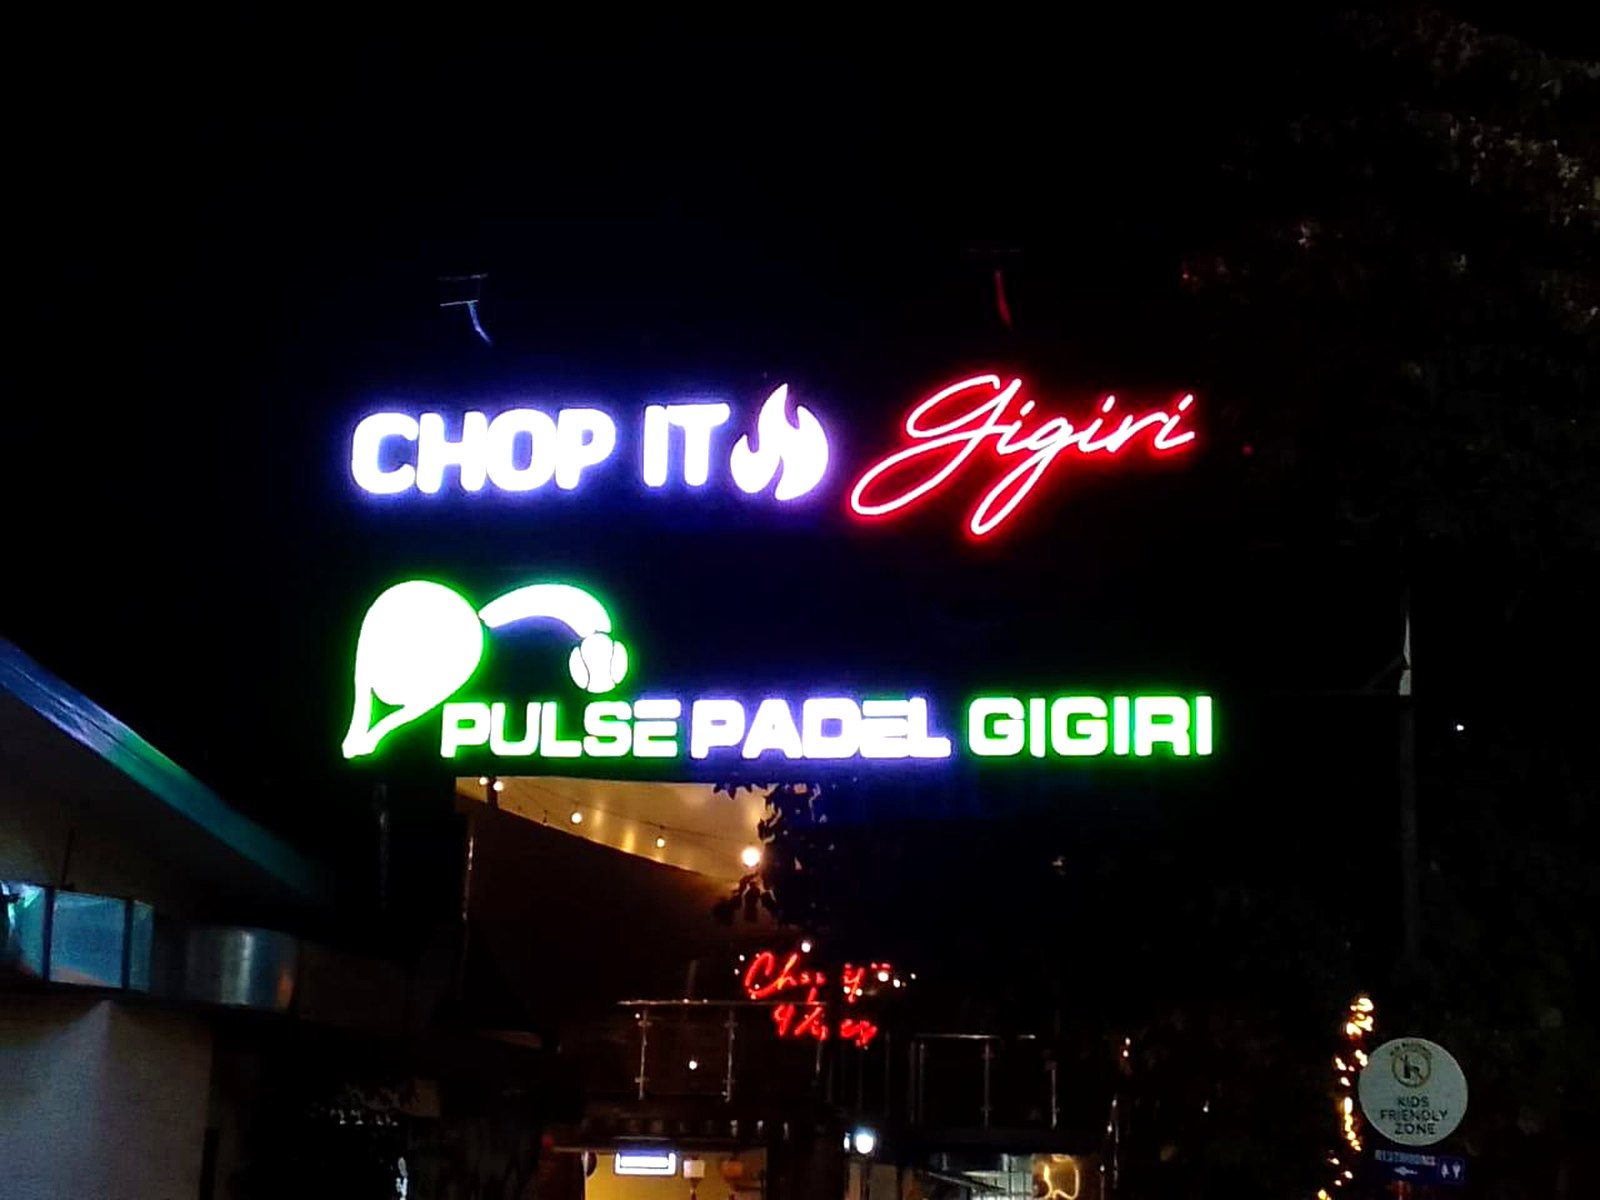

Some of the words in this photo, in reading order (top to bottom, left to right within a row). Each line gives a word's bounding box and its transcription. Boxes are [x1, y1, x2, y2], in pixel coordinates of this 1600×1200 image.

[351, 408, 617, 495] CHOP
[643, 402, 731, 487] IT
[850, 374, 1196, 536] Gigiri
[440, 699, 682, 758] PULSE
[690, 698, 952, 759] PADEL
[968, 696, 1213, 758] GIGIRI
[1397, 1096, 1429, 1108] KIDS
[1380, 1109, 1448, 1121] FRIENDLY
[1395, 1122, 1436, 1135] ZONE
